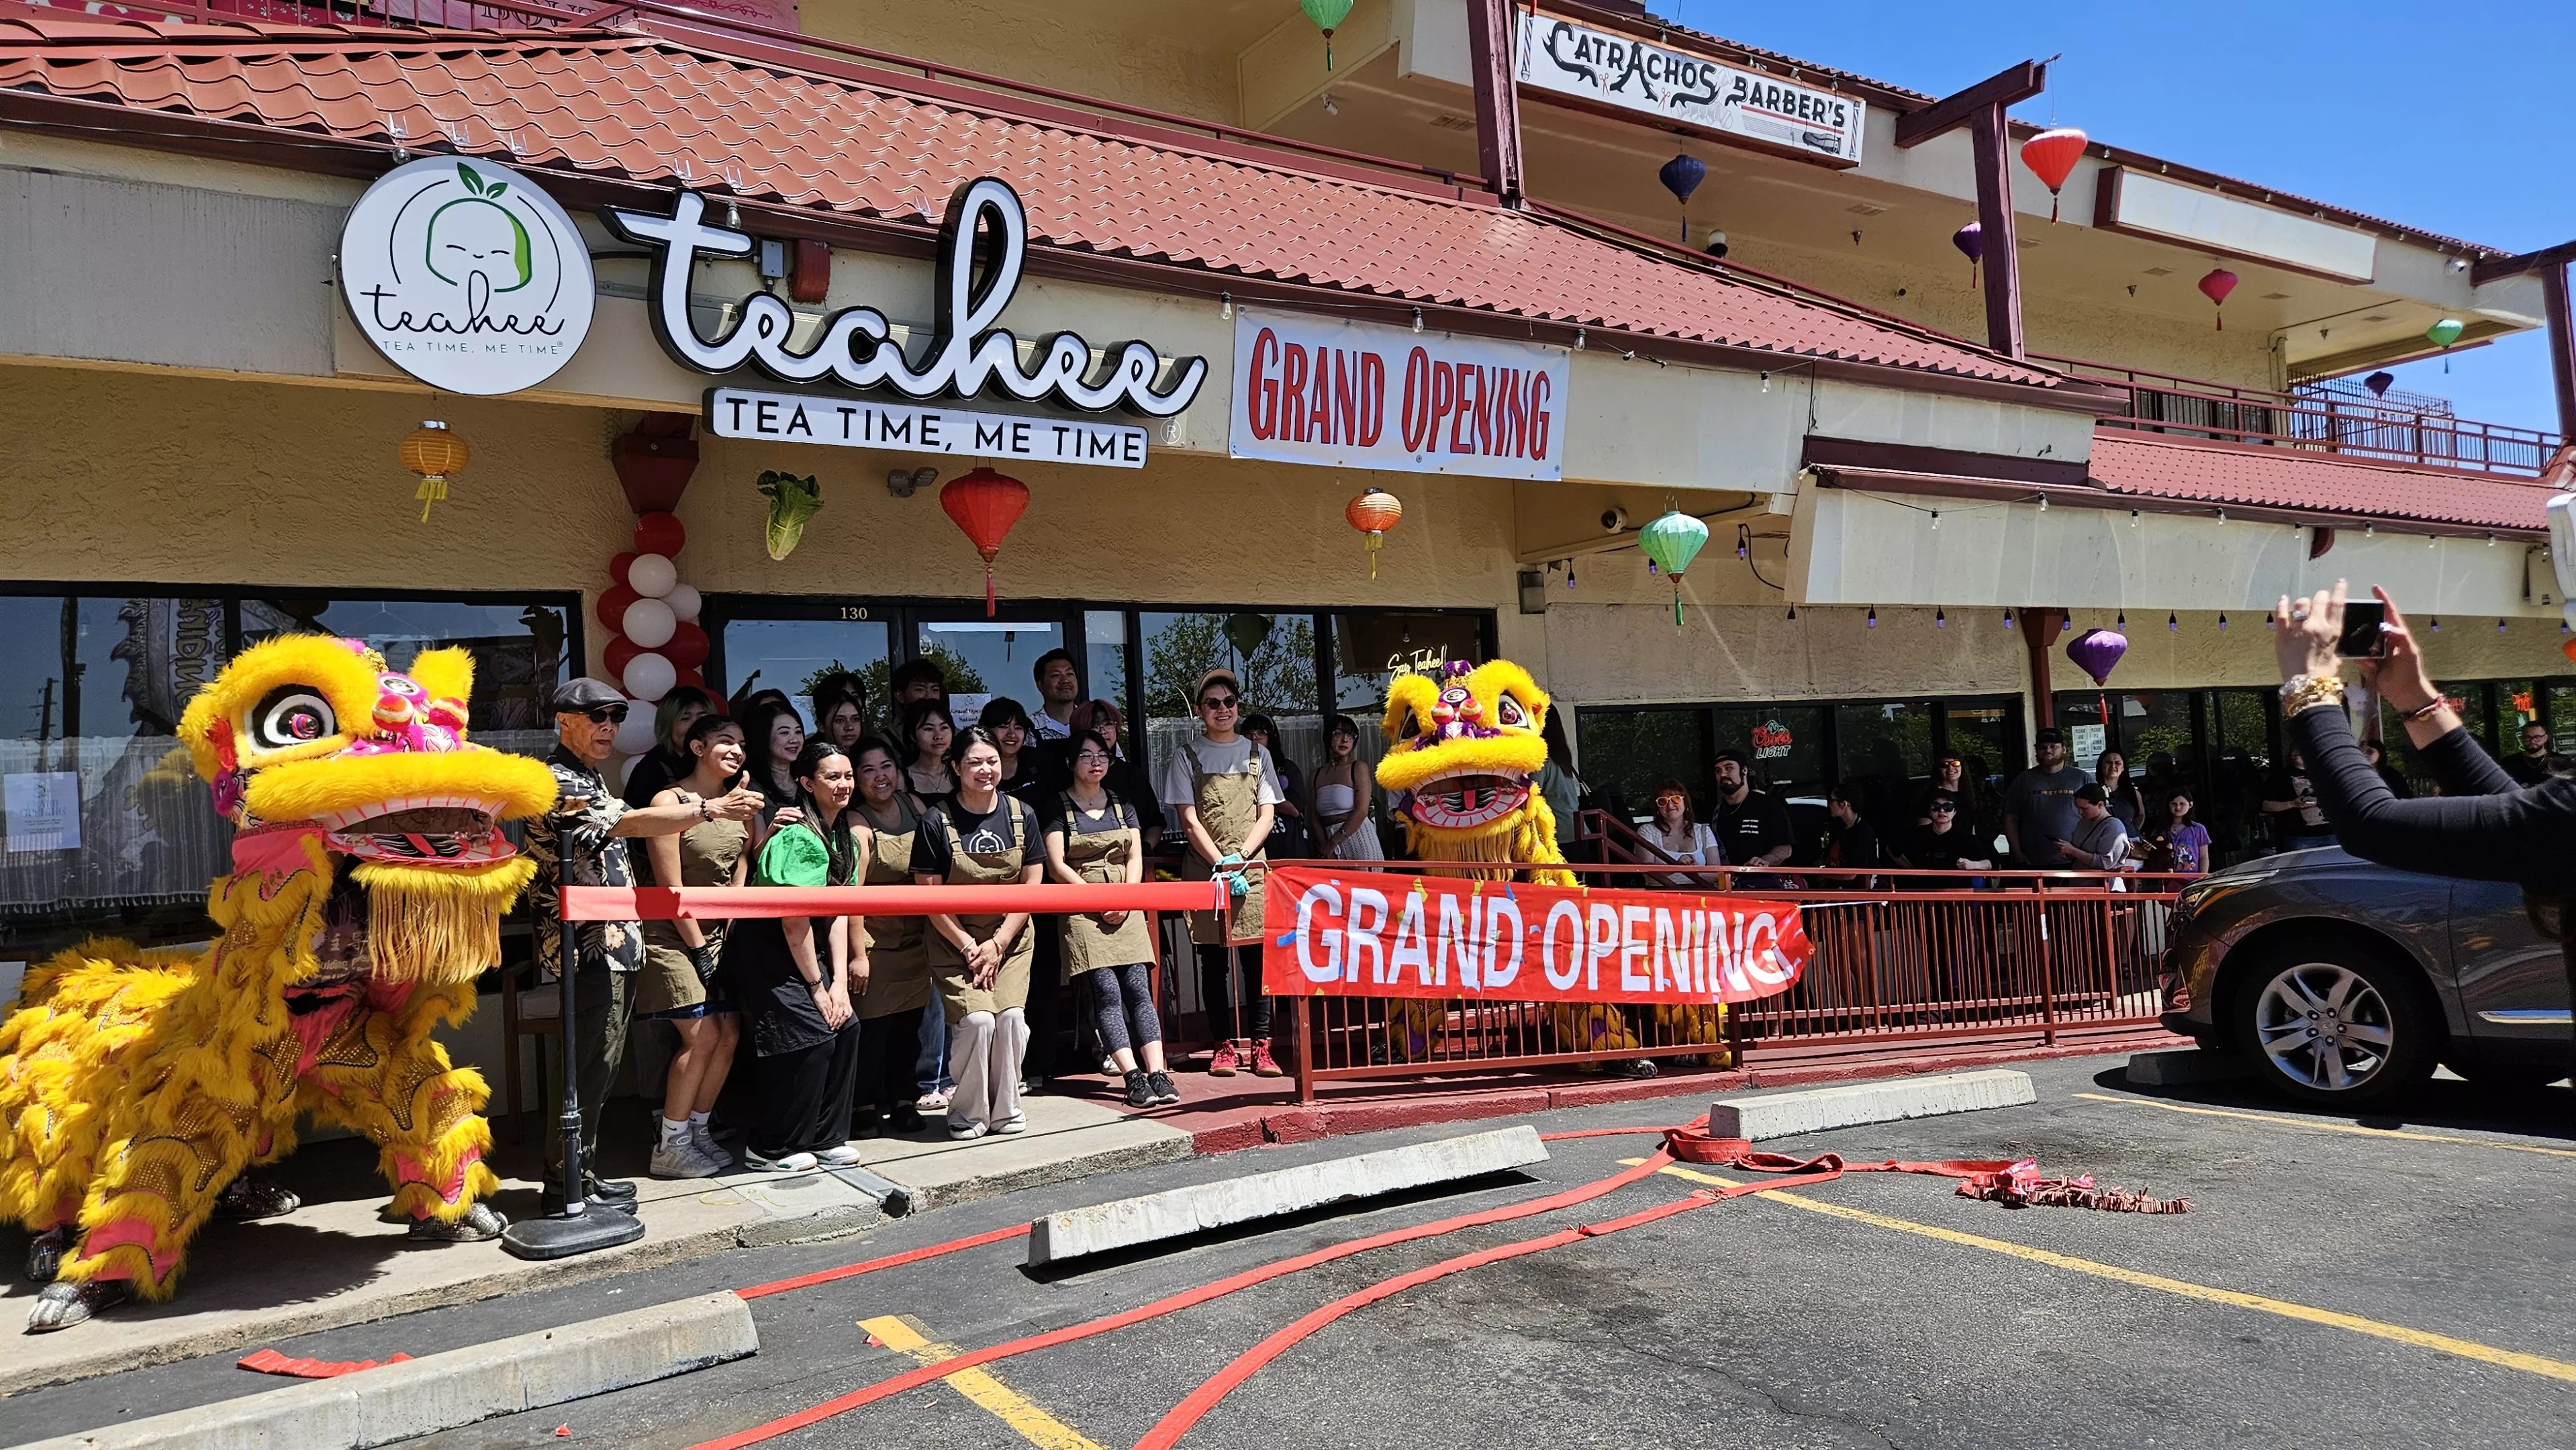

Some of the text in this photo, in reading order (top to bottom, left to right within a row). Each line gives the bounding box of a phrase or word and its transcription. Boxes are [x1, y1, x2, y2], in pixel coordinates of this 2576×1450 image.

[1725, 75, 1846, 128] BARBER'S
[360, 270, 565, 335] teahee
[610, 177, 1208, 418] teahee
[383, 341, 415, 351] TEA
[485, 344, 508, 353] ME
[1248, 327, 1551, 461] GRAND OPENING
[726, 397, 1141, 463] TEA TIME, ME TIME
[840, 607, 868, 620] 130
[1756, 745, 1791, 759] LIGHT
[1296, 884, 1794, 993] GRAND OPENING
